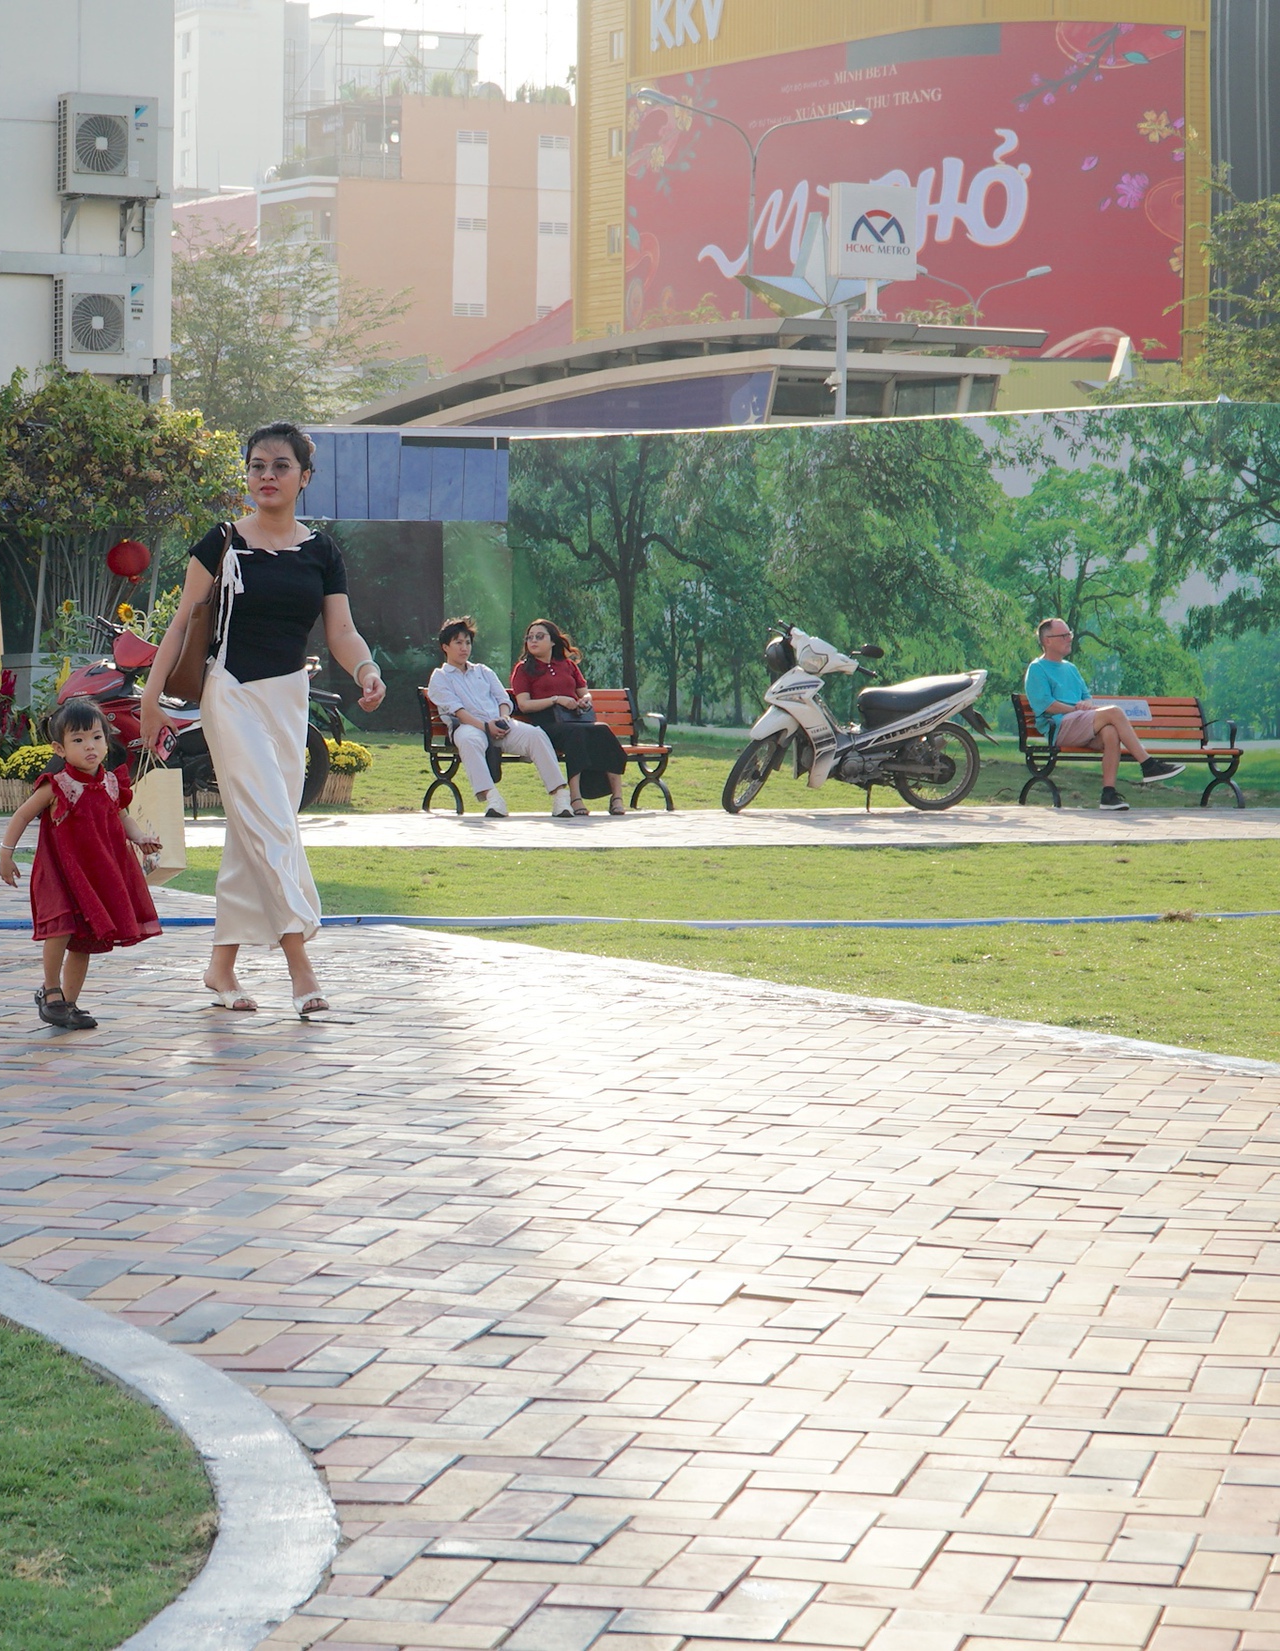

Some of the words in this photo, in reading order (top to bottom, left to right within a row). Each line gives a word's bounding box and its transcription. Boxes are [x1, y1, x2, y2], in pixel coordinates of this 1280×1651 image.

[650, 0, 724, 52] KKV
[834, 69, 862, 84] MINH
[866, 64, 898, 79] BETA
[893, 87, 942, 106] TRANG
[846, 243, 874, 253] HCMC
[877, 245, 910, 256] METRO
